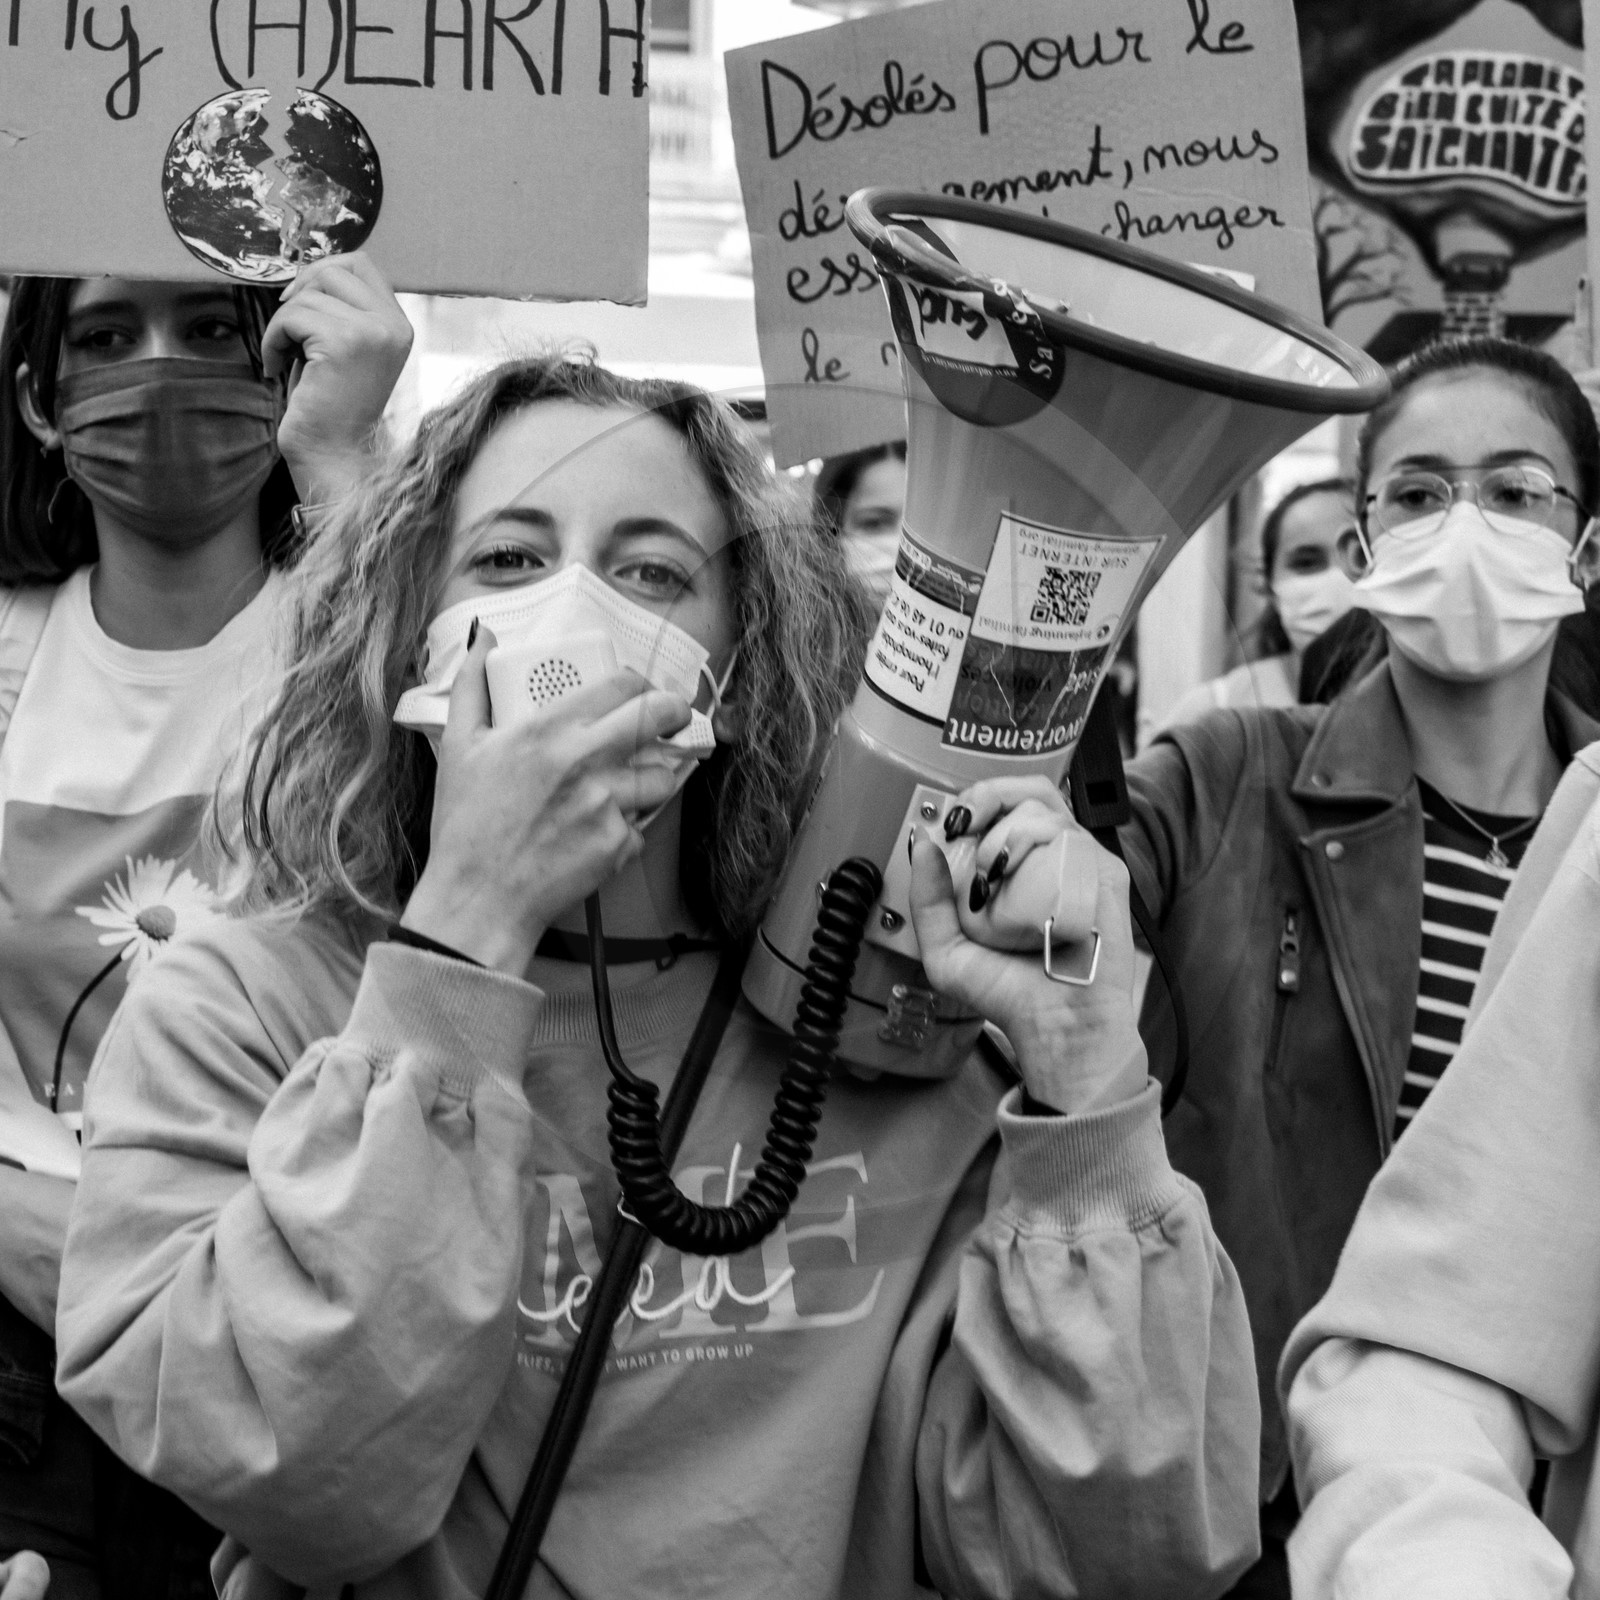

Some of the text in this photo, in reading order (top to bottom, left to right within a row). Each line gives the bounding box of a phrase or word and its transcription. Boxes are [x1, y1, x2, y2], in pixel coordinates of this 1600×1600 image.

[761, 0, 1254, 160] Désolés pour le
[1143, 129, 1280, 175] nous
[1101, 200, 1285, 250] hanger
[802, 326, 850, 383] le
[1019, 542, 1099, 568] INTERNET
[911, 608, 926, 626] 48
[929, 618, 945, 637] 01
[947, 626, 965, 640] au
[899, 668, 925, 692] Pour
[616, 1353, 658, 1373] WANT
[661, 1348, 682, 1366] TO
[684, 1345, 730, 1363] GROW
[734, 1343, 756, 1360] UP
